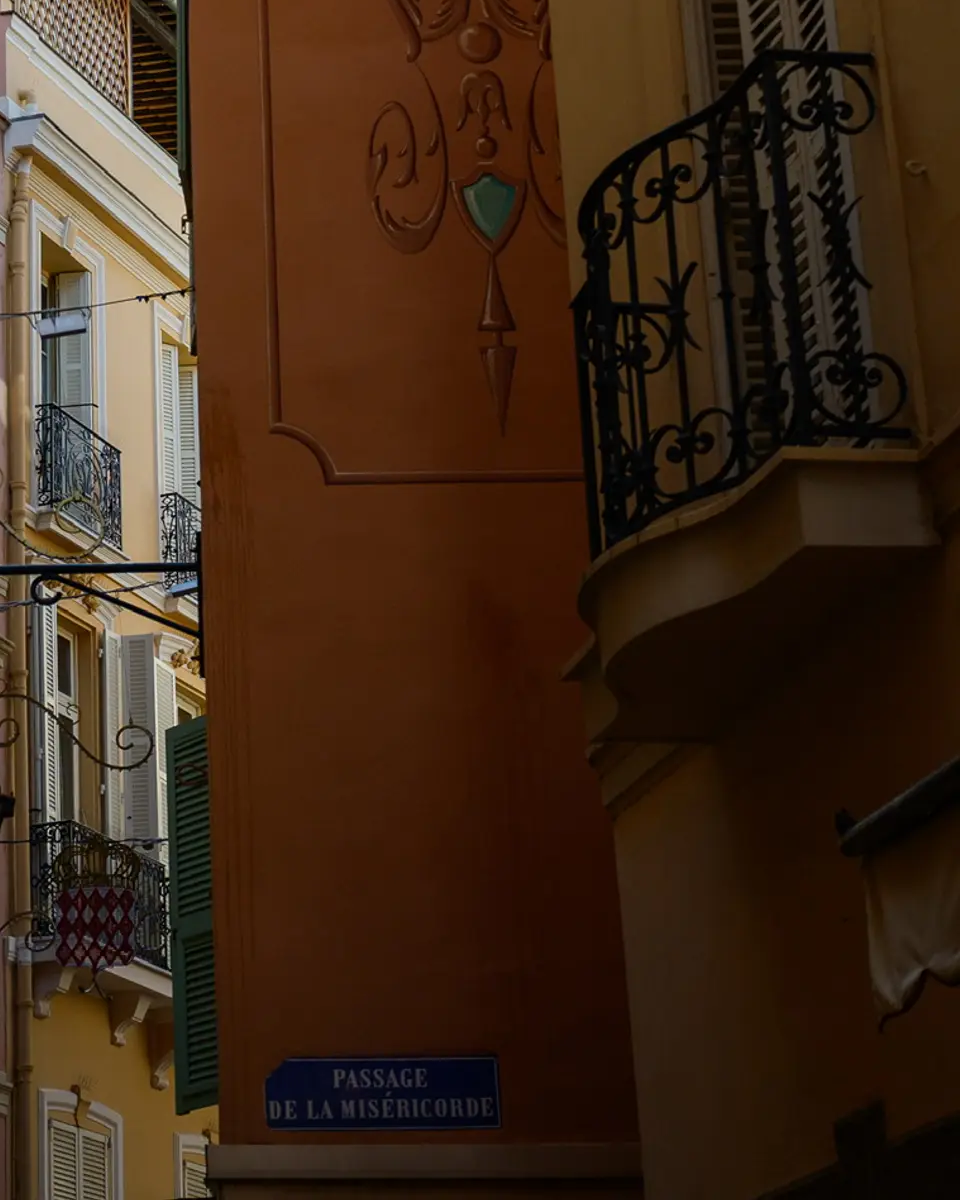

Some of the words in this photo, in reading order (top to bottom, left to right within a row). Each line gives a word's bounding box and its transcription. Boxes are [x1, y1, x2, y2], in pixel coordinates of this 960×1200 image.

[333, 1068, 428, 1088] PASSAGE
[269, 1100, 297, 1120] DE
[307, 1100, 334, 1120] LA
[341, 1091, 494, 1119] MISÉRICORDE
